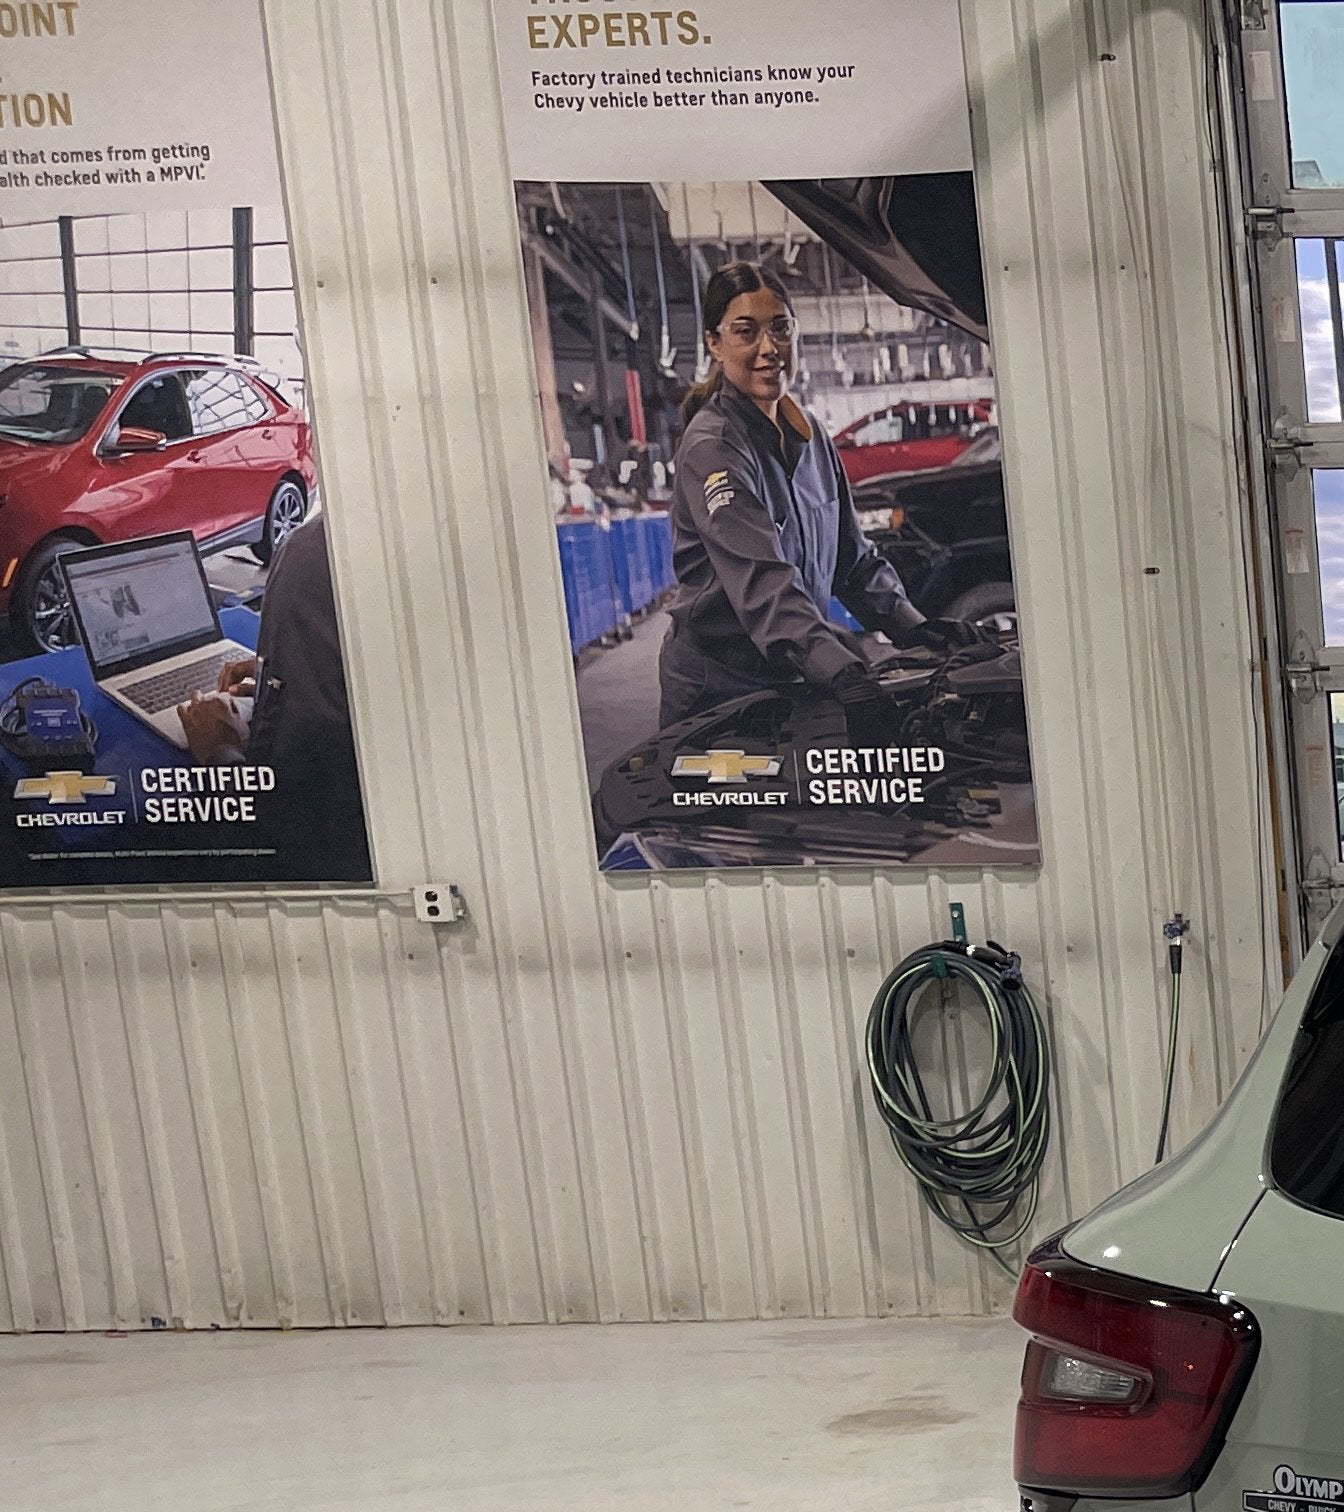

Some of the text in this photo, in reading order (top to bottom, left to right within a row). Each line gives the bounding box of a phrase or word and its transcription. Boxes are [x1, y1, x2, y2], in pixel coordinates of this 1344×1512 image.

[527, 10, 712, 49] EXPERTS.
[532, 64, 855, 89] Factory trained technicians know your
[534, 89, 820, 112] Chevy vehicle better than anyone.
[12, 149, 47, 165] that
[51, 149, 103, 164] comes
[107, 145, 147, 162] from
[151, 143, 210, 164] getting
[34, 169, 101, 187] checked
[105, 167, 142, 184] with
[146, 170, 156, 182] a
[806, 747, 945, 775] CERTIFIED
[140, 765, 277, 792] CERTIFIED
[673, 791, 789, 806] CHEVROLET
[808, 778, 925, 805] SERVICE
[16, 810, 126, 828] CHEVROLET
[144, 796, 257, 823] SERVICE
[1268, 1499, 1296, 1512] CHEVY
